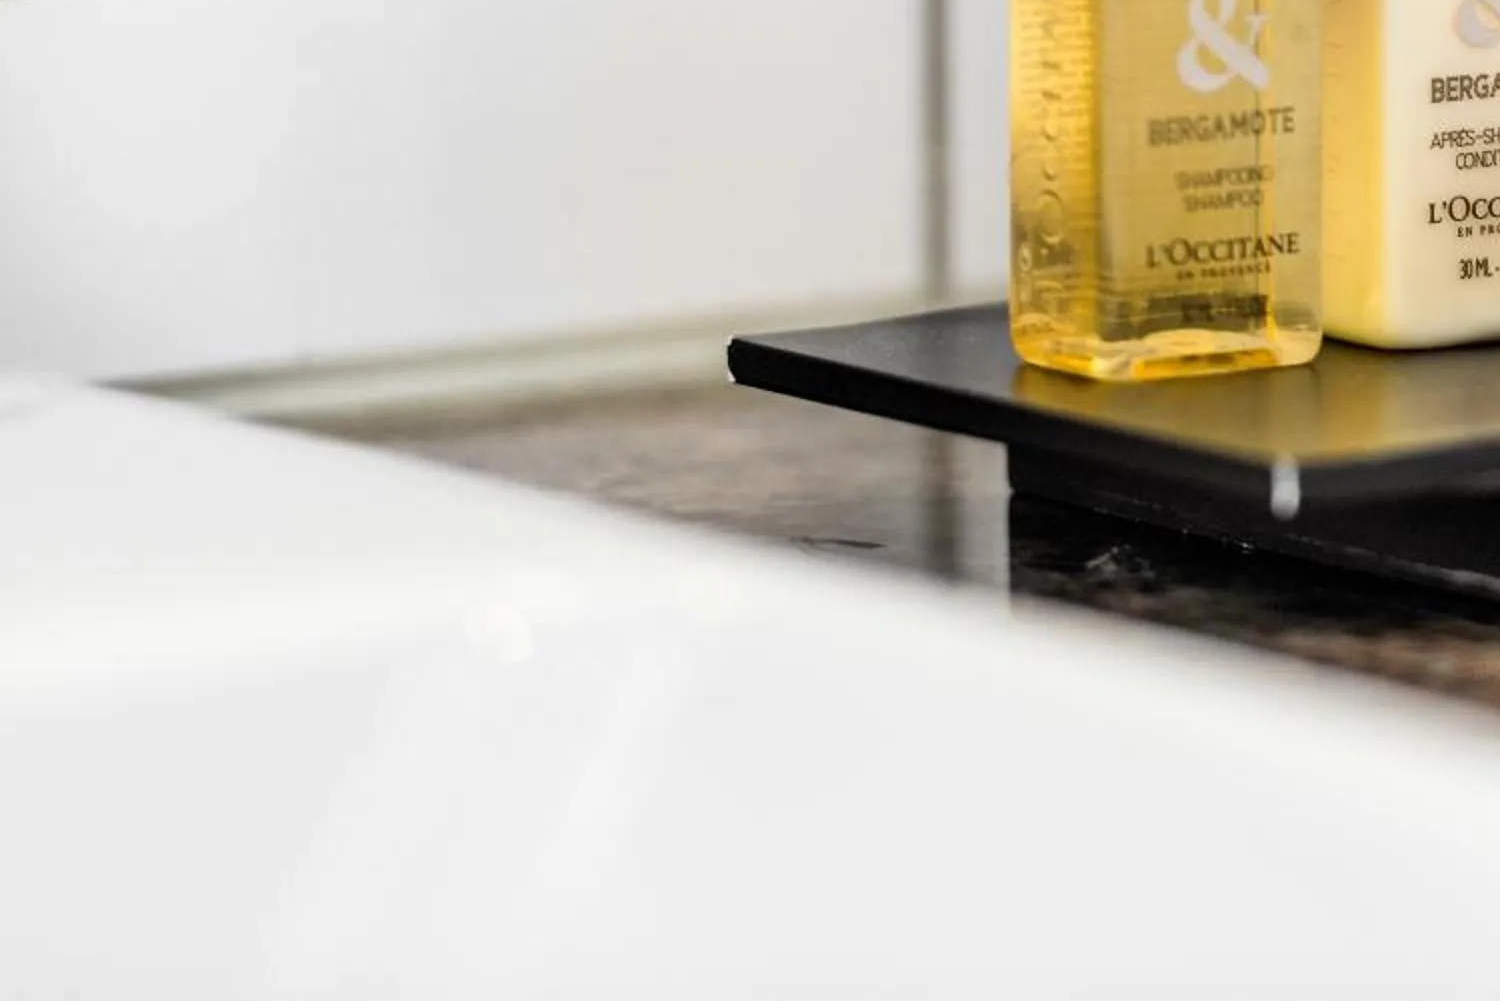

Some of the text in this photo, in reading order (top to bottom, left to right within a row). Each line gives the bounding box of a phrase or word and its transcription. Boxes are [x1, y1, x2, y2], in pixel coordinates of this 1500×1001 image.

[1147, 106, 1295, 147] BERGAMOTE
[1457, 226, 1473, 238] EN
[1146, 231, 1302, 269] L'OCCITANE
[1460, 258, 1473, 279] 30
